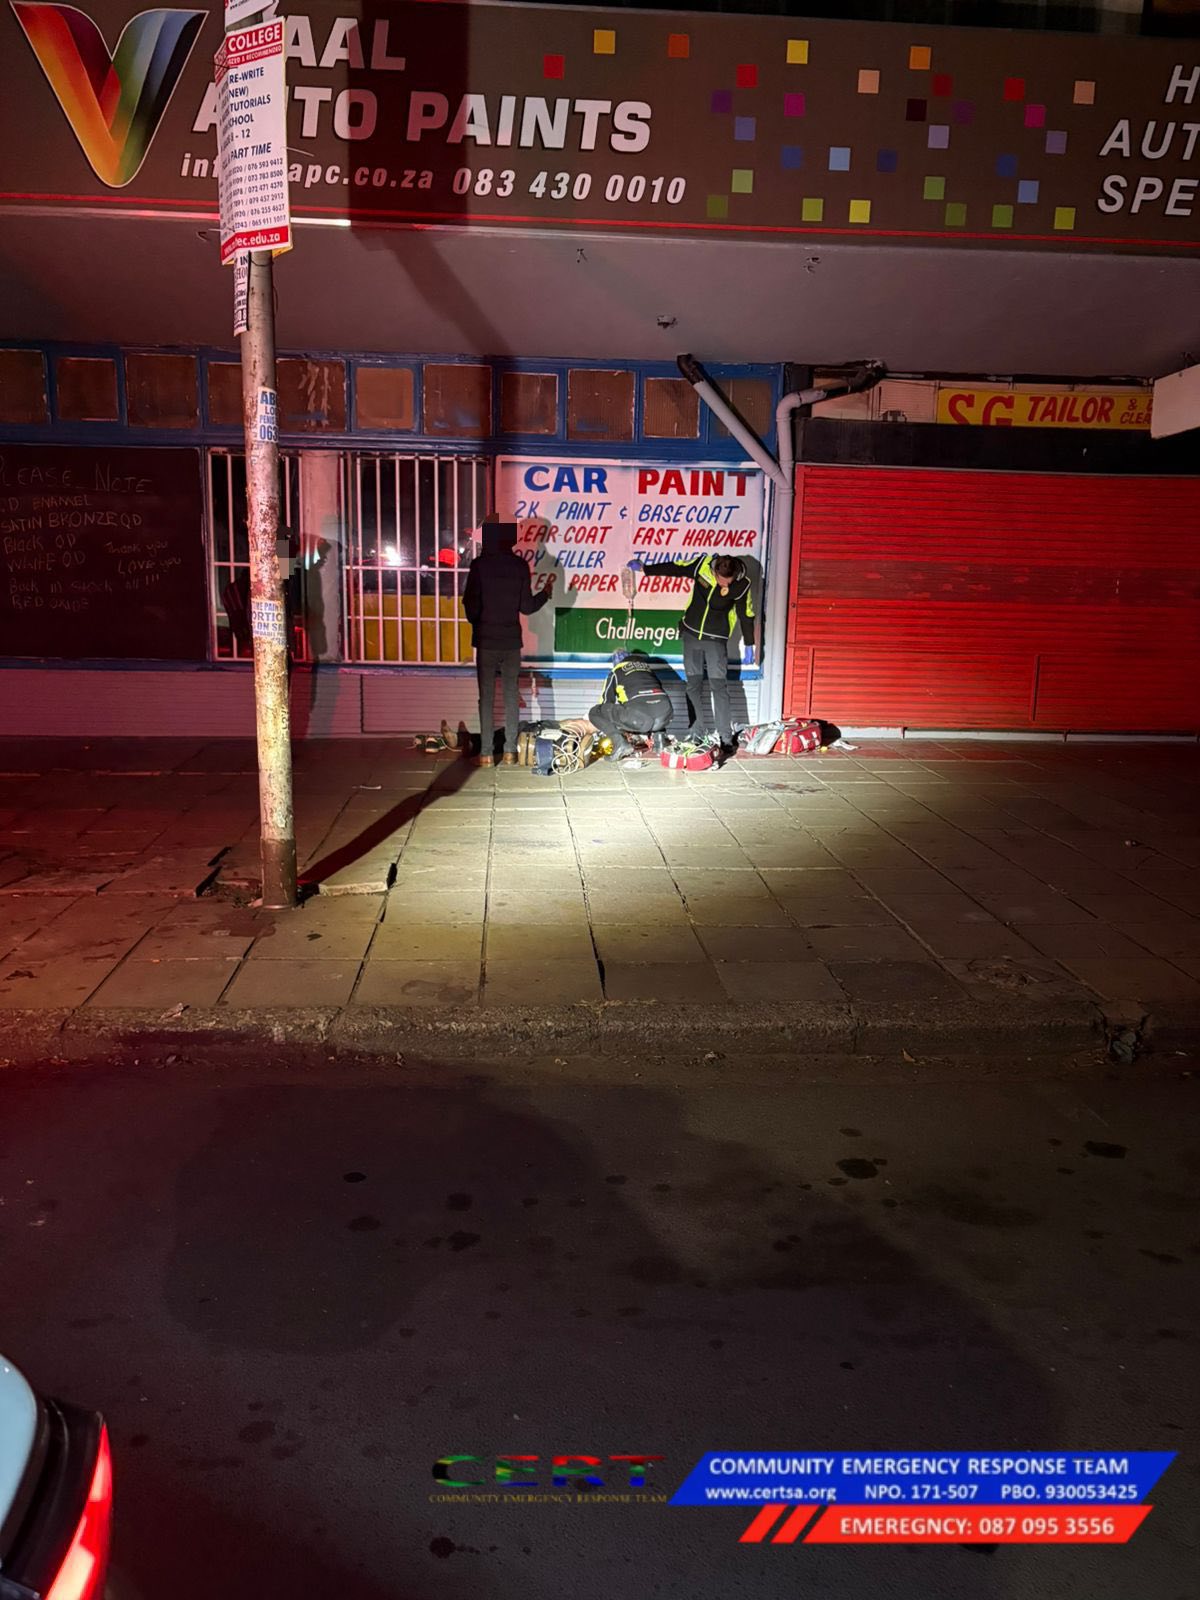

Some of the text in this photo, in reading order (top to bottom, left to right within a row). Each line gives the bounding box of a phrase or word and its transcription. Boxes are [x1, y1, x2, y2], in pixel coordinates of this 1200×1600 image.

[228, 24, 281, 51] COLLEGE
[229, 67, 264, 84] RE-WRITE
[230, 94, 271, 112] TUTORIALS
[407, 91, 652, 153] PAINTS
[241, 128, 251, 139] 12
[1100, 120, 1200, 160] AUT
[231, 142, 272, 159] PART TIME
[453, 167, 516, 197] 083
[529, 172, 592, 200] 430
[605, 174, 686, 204] 0010
[1098, 175, 1200, 216] SPE
[1027, 396, 1116, 423] TAILOR
[1128, 398, 1138, 411] &
[260, 425, 278, 441] 063
[524, 466, 757, 496] CAR PAINT
[514, 501, 540, 519] 2K
[555, 502, 612, 521] PAINT
[1, 516, 42, 533] SATIN
[518, 525, 757, 547] LEAR-COAT FAST HARDNER
[514, 549, 606, 568] ODY FILLER
[568, 574, 619, 592] PAPER
